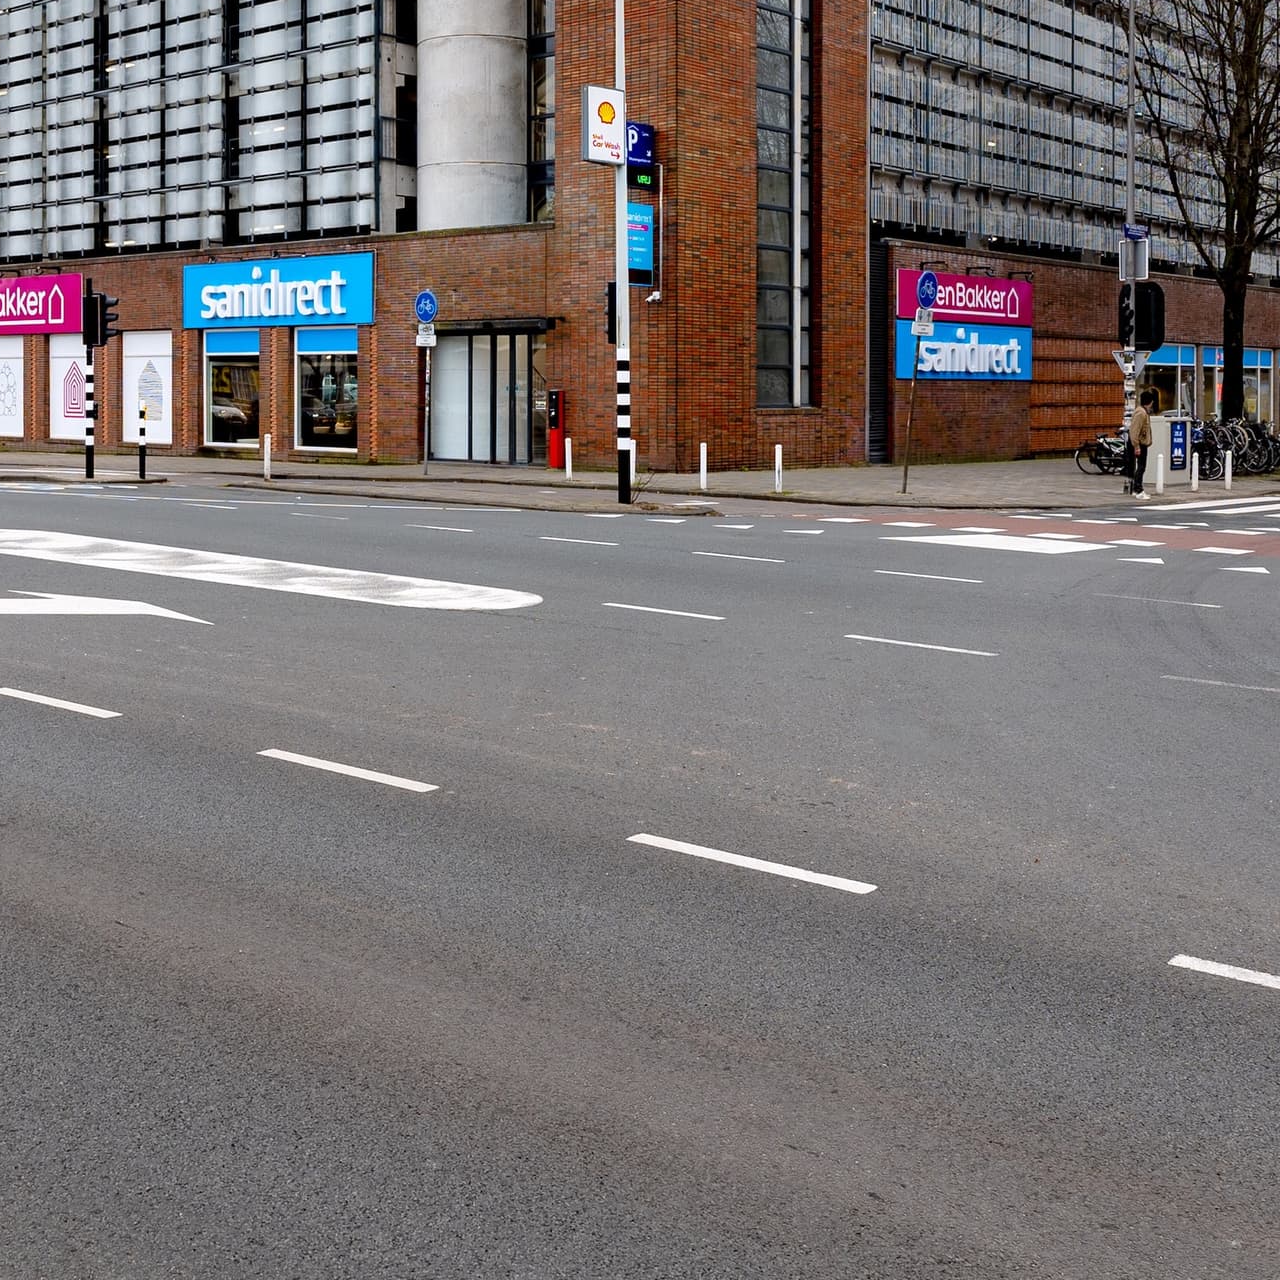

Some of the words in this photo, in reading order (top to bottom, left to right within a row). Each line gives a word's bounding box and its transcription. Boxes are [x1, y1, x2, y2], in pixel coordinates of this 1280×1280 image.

[592, 140, 604, 148] Car
[605, 140, 621, 151] Wash
[628, 129, 638, 152] P
[201, 266, 347, 319] sanidirect
[936, 282, 1006, 310] enBakker
[917, 328, 1021, 374] sanidirect
